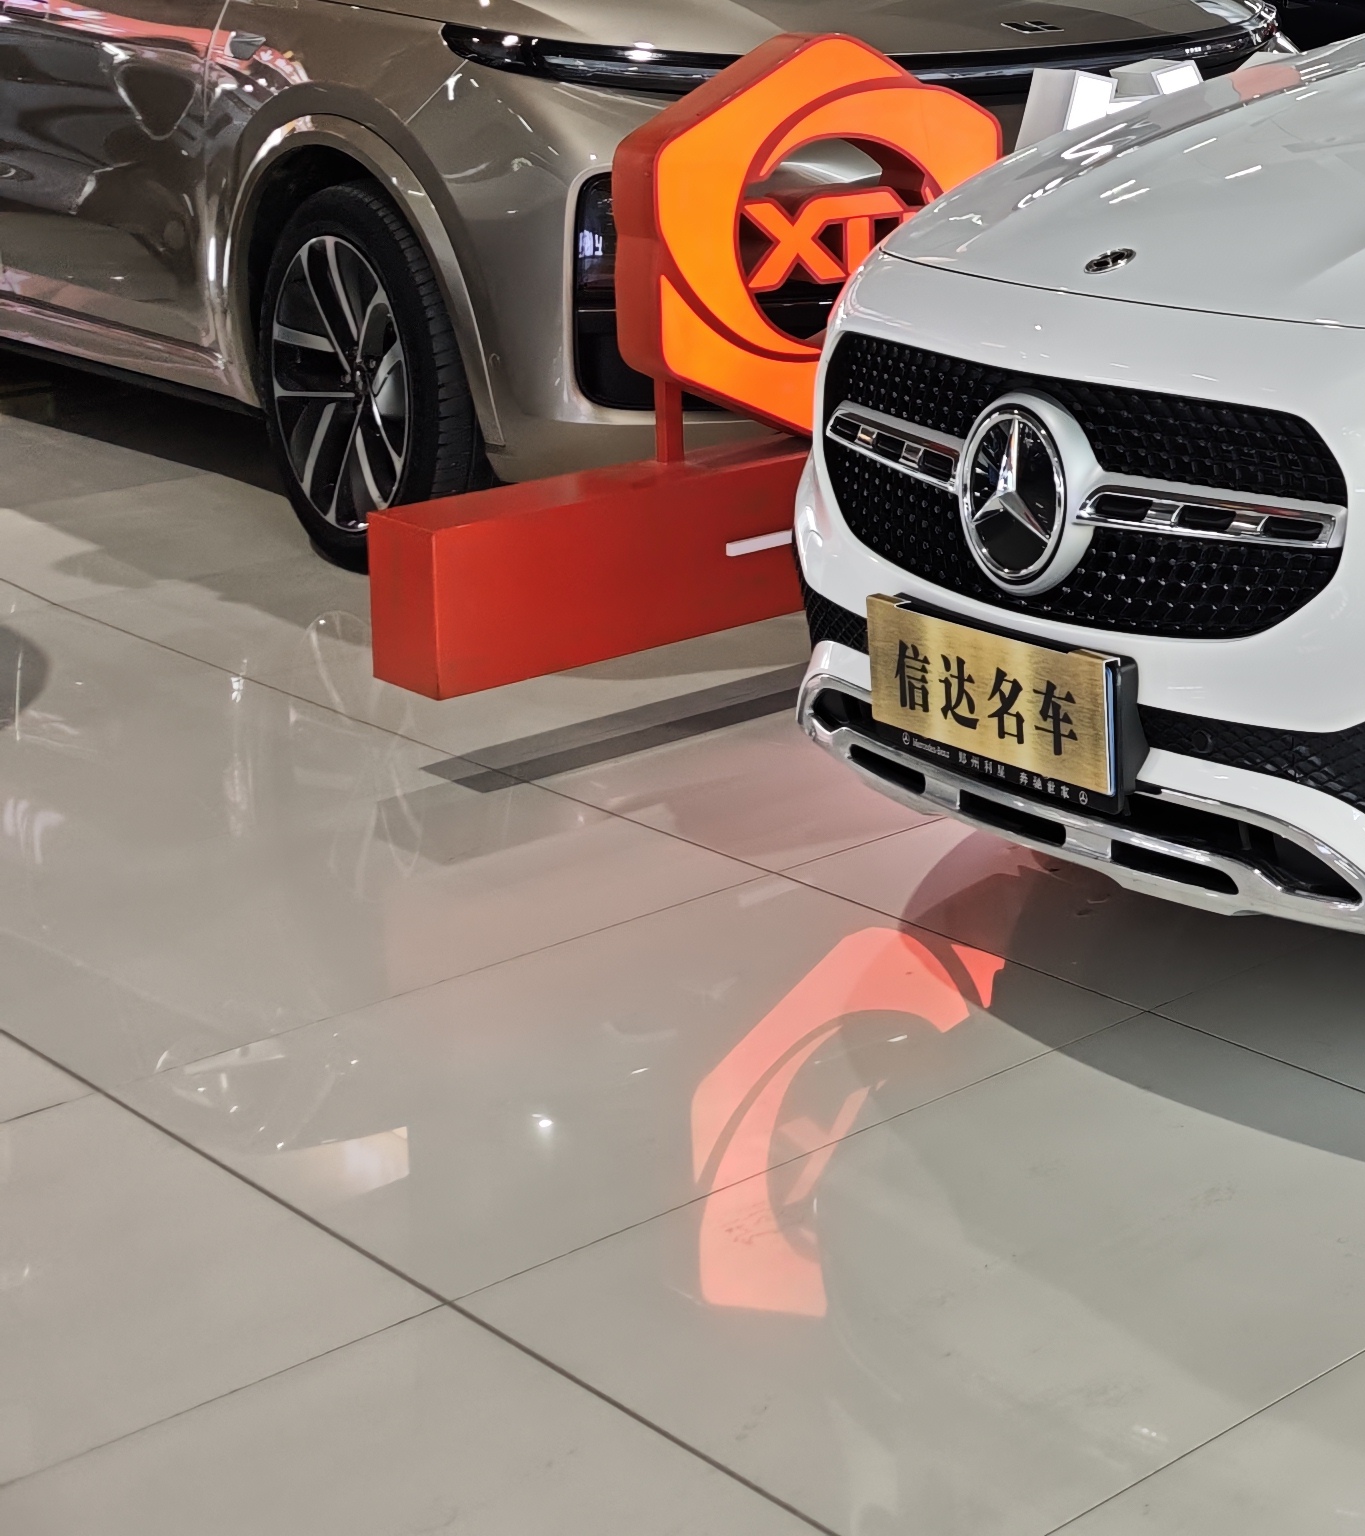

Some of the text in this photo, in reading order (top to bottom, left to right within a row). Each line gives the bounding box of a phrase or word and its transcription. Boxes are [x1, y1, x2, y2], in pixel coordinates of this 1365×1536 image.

[893, 638, 1079, 757] 信达名车
[912, 737, 950, 760] Mercedes-Benz
[1019, 771, 1070, 800] 奔驰世家
